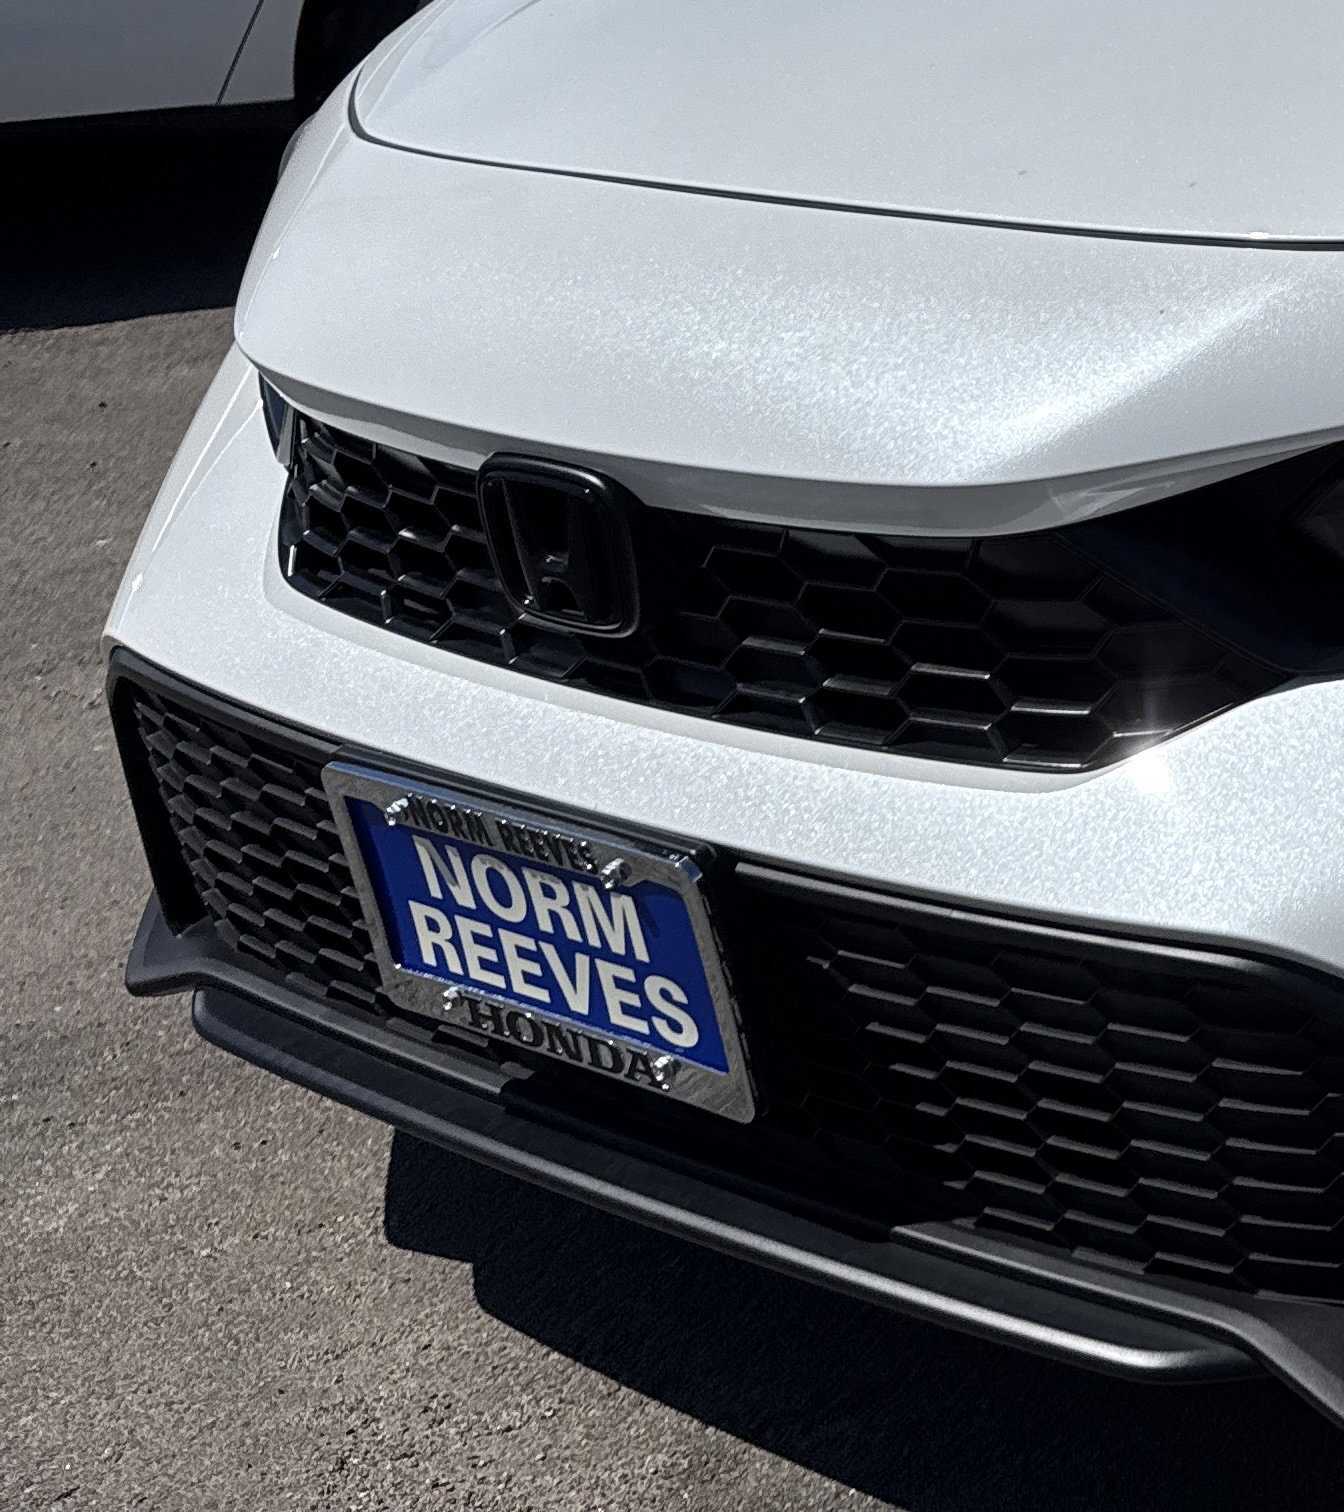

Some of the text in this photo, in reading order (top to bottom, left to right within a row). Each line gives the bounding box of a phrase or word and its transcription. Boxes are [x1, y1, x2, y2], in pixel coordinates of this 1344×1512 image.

[412, 835, 650, 964] NORM
[408, 901, 700, 1049] REEVES
[461, 992, 668, 1090] HONDA
